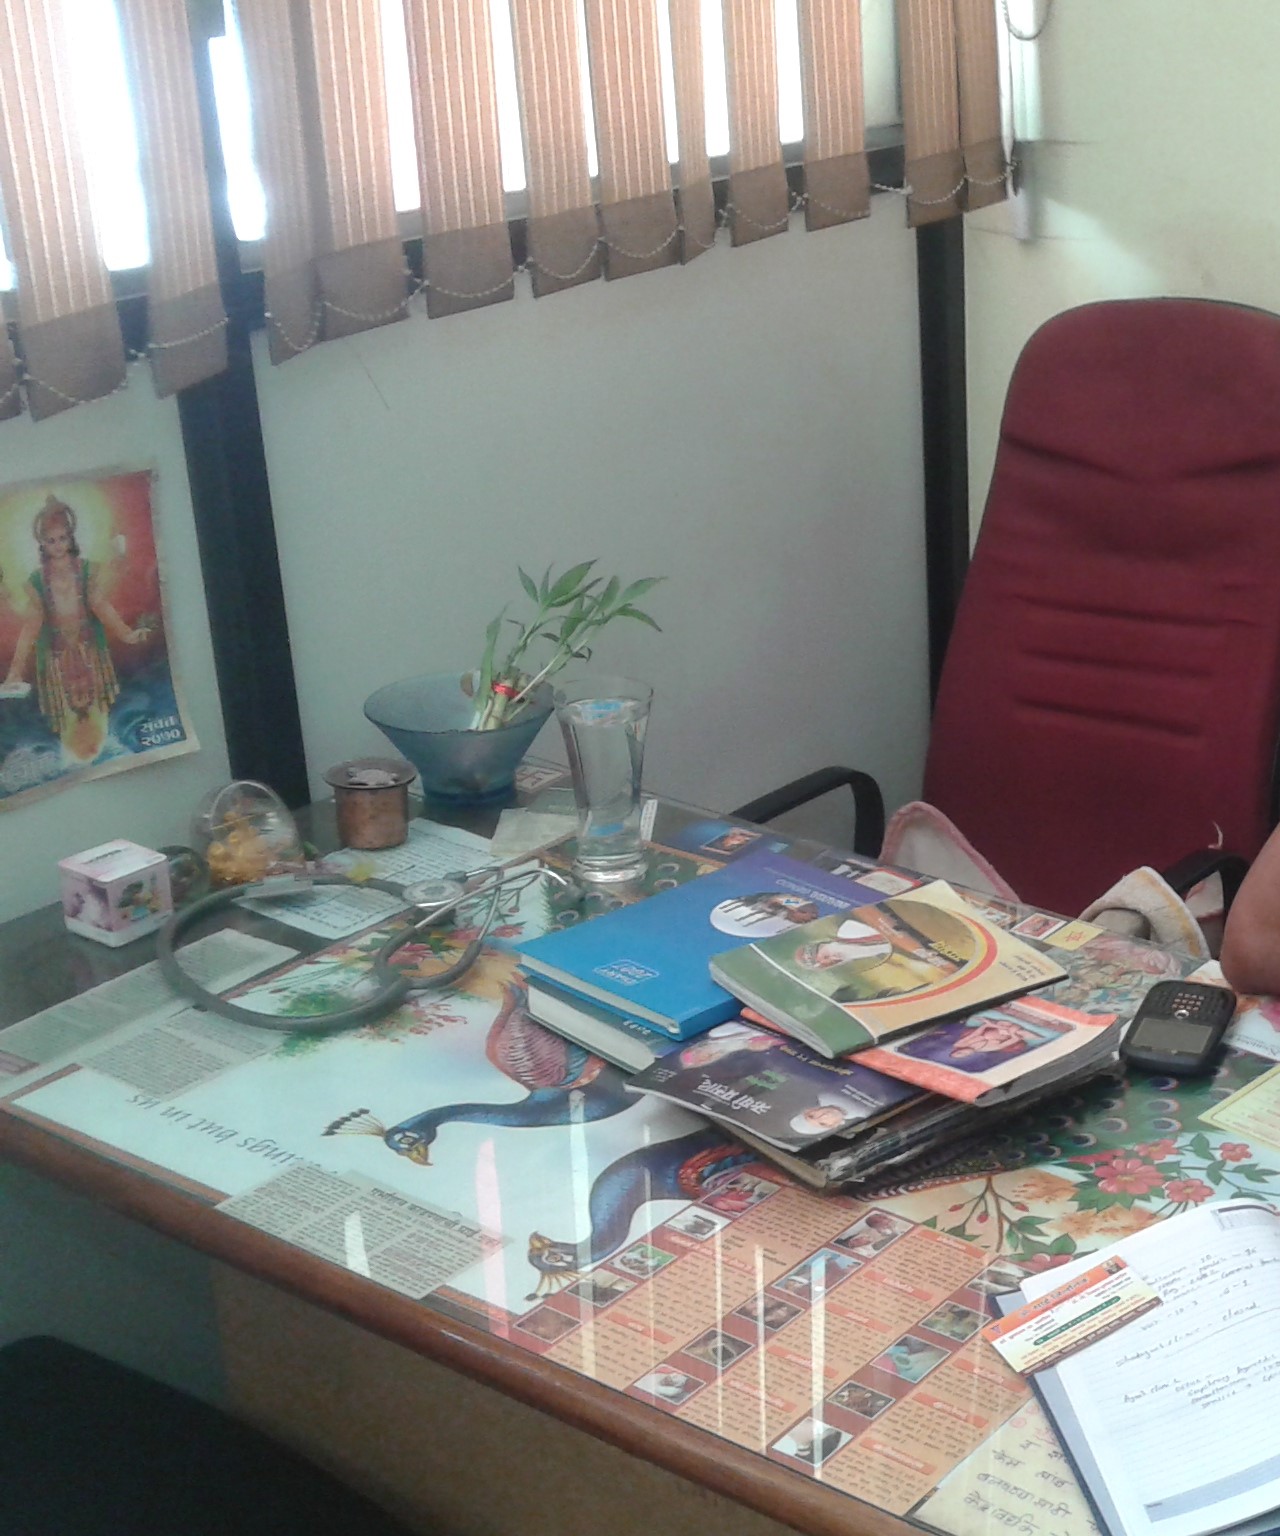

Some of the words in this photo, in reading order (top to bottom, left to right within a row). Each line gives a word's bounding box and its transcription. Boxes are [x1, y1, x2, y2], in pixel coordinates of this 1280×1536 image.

[127, 1094, 161, 1110] us
[160, 1105, 192, 1125] in
[186, 1117, 239, 1144] but
